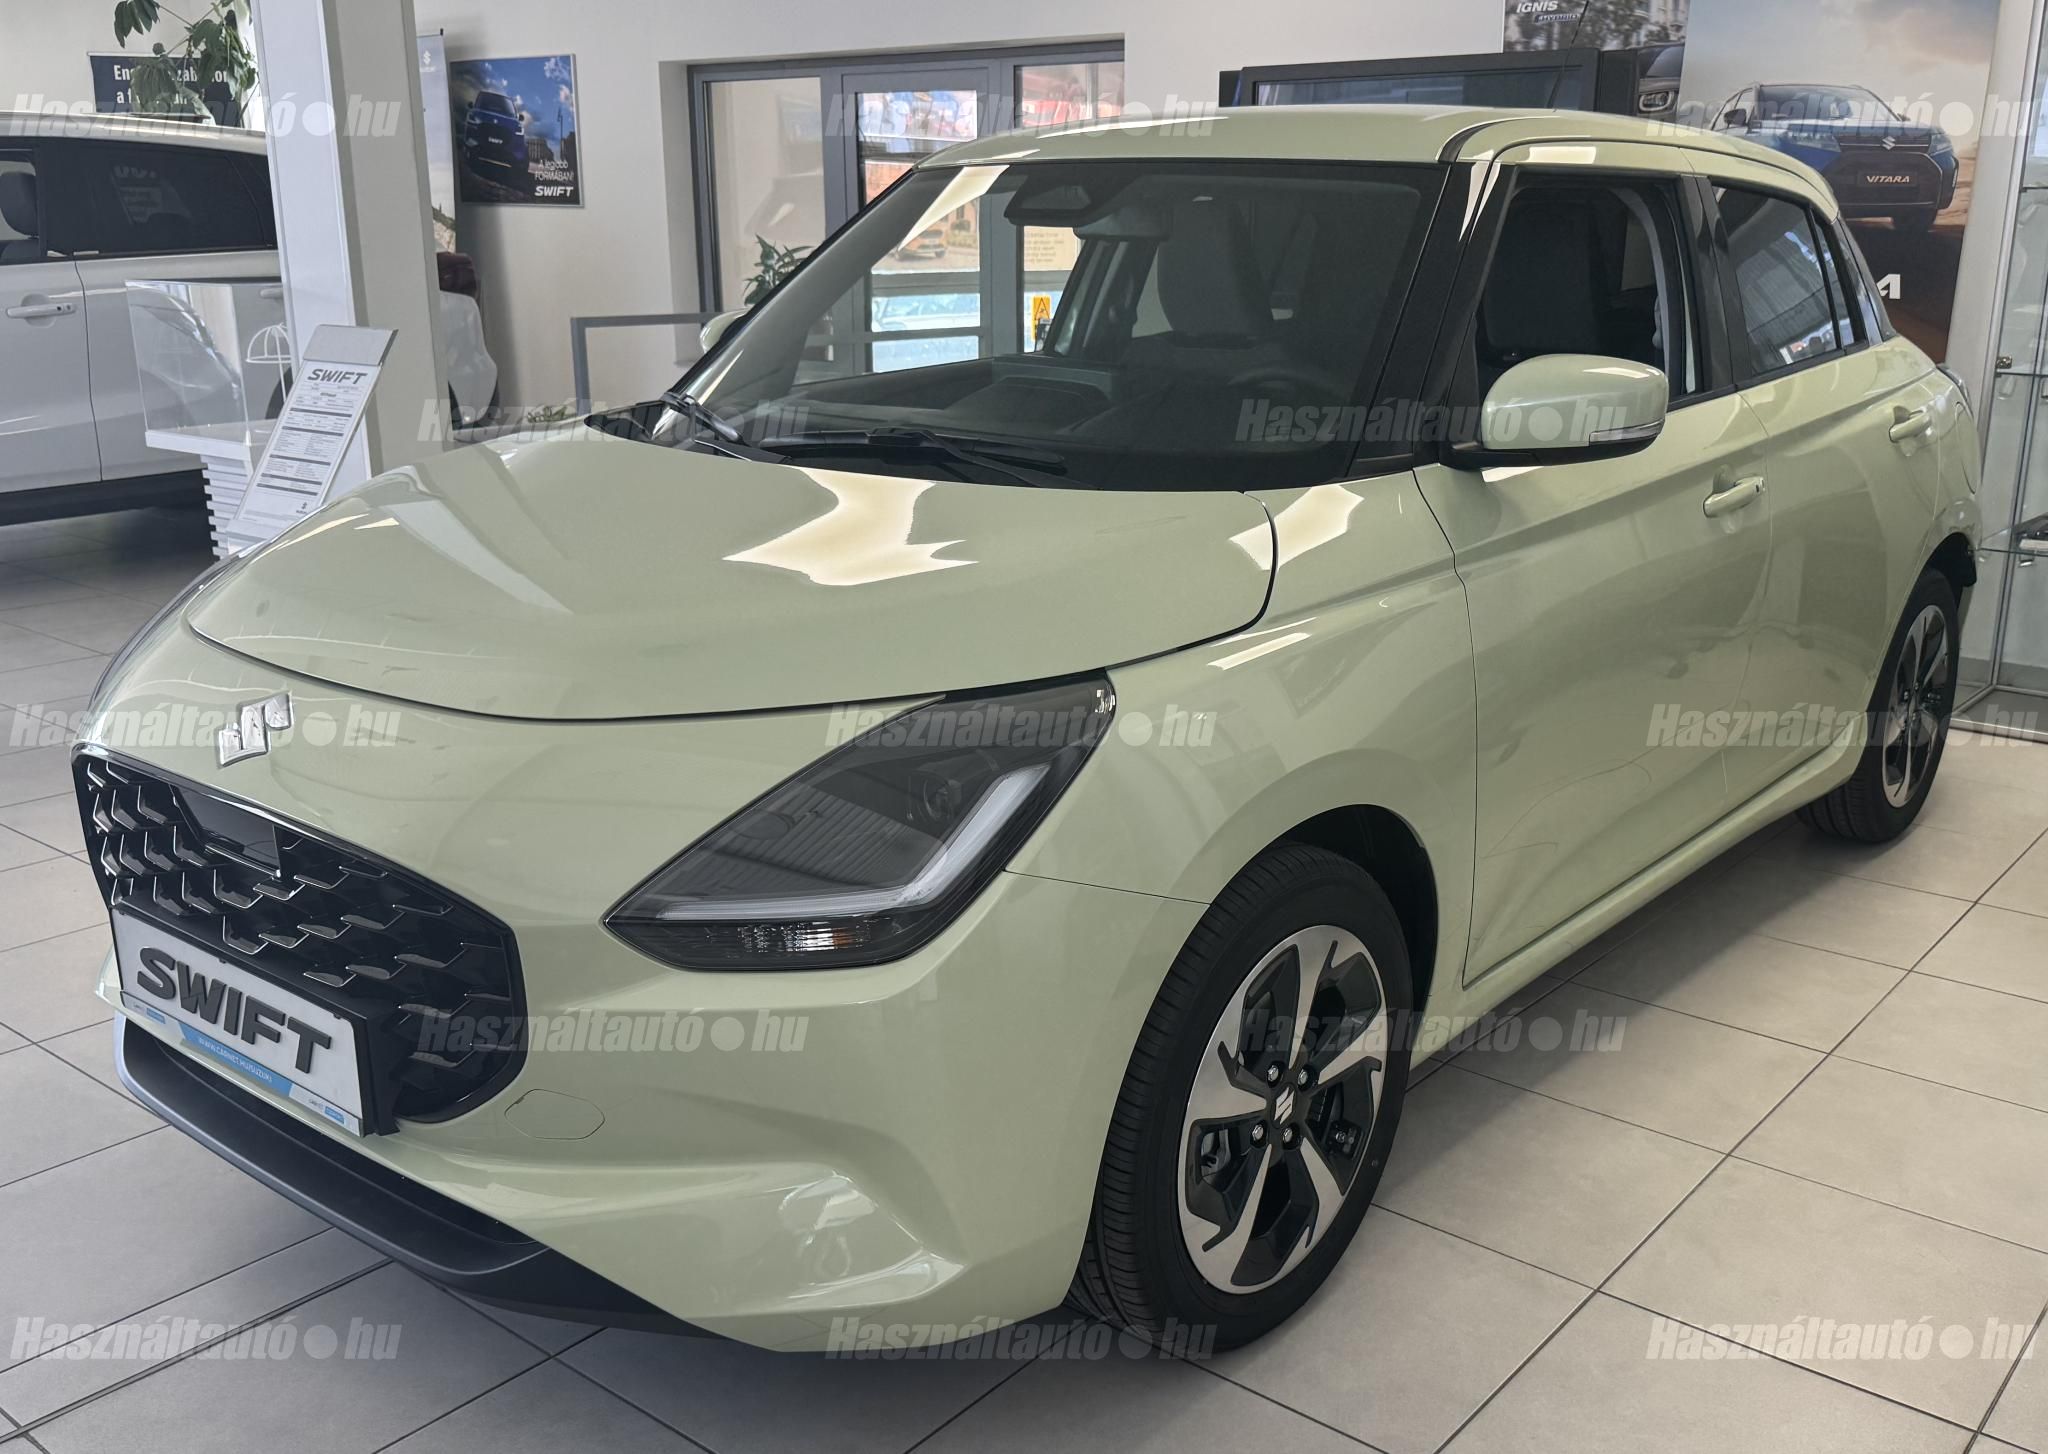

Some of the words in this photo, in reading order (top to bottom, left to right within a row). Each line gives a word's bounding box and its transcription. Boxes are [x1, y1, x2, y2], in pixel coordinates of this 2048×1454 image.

[1516, 0, 1558, 13] IGNIS
[1866, 175, 1910, 183] VITARA
[534, 185, 574, 197] SWIFT
[307, 368, 368, 385] SWIFT
[137, 946, 332, 1074] SWIFT
